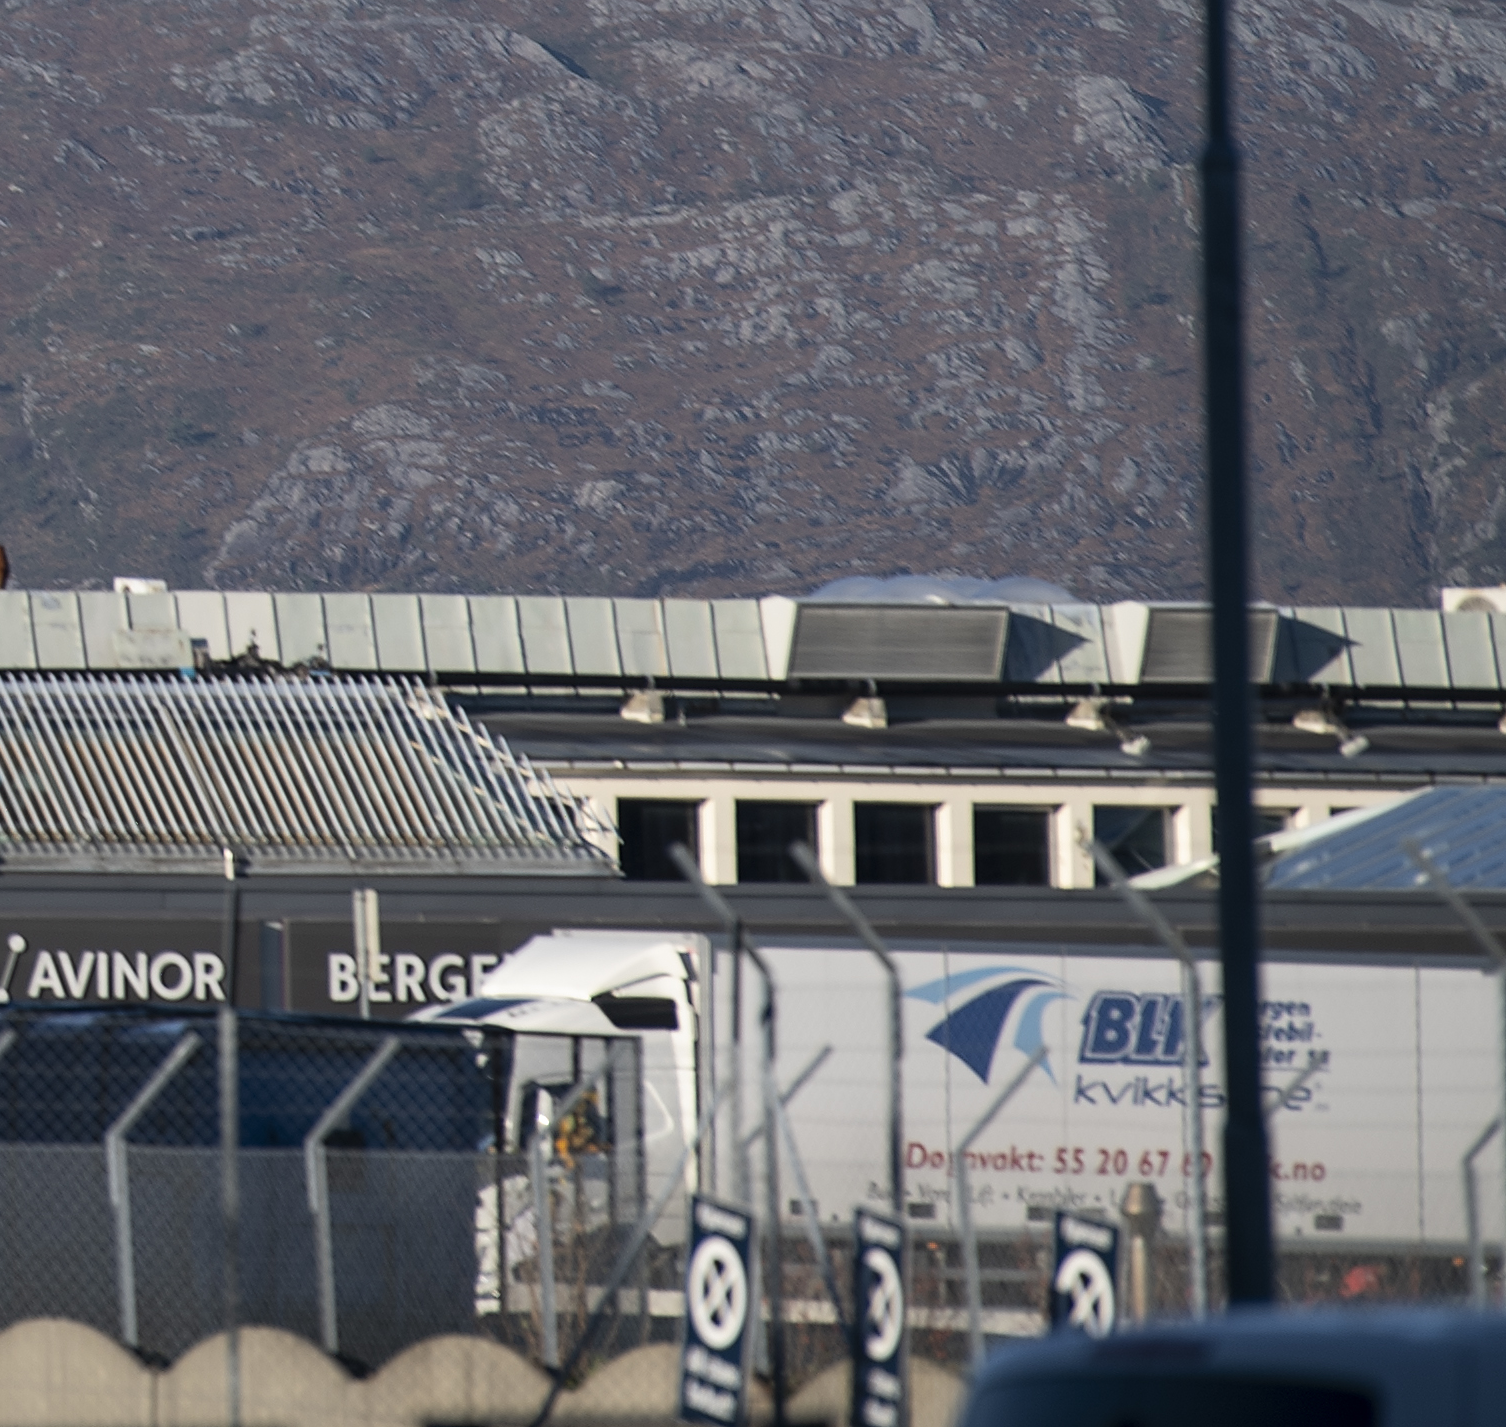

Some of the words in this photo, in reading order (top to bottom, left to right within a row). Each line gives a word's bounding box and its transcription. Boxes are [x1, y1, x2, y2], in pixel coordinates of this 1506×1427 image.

[28, 950, 226, 1001] AVINOR
[328, 952, 514, 1004] BERGE
[1053, 1147, 1085, 1174] 55
[1097, 1148, 1128, 1175] 20
[1139, 1149, 1169, 1176] 67
